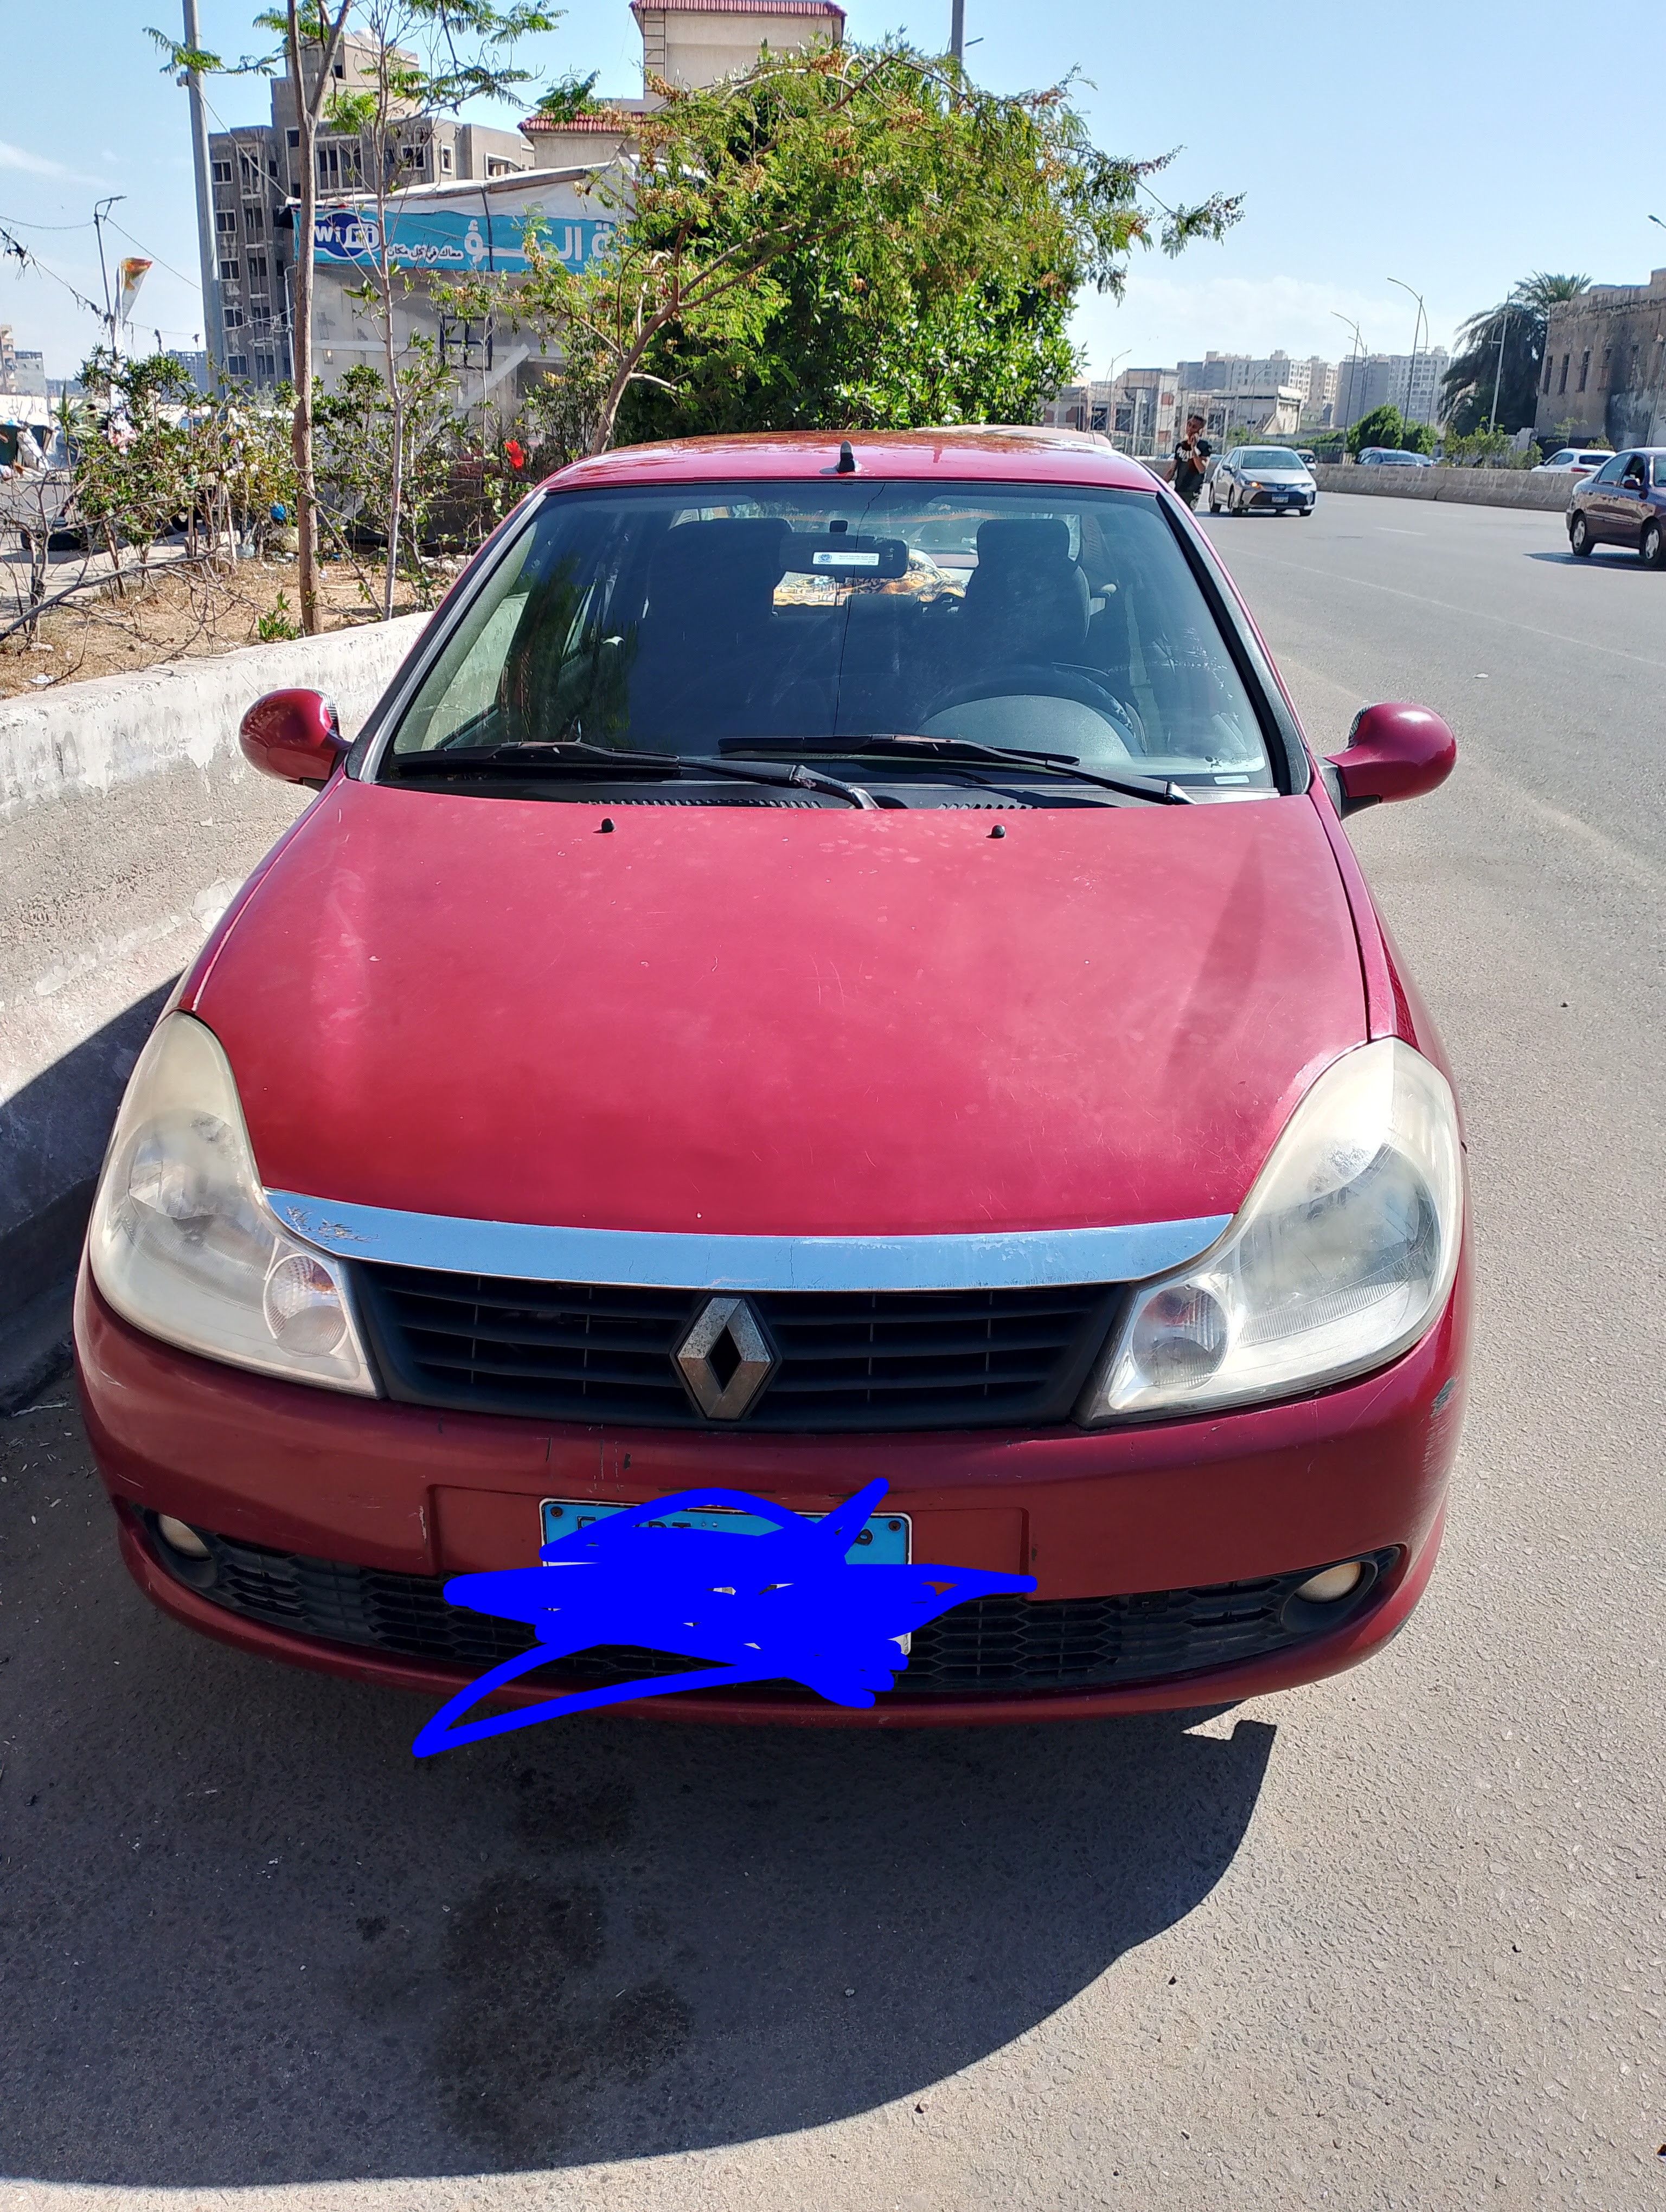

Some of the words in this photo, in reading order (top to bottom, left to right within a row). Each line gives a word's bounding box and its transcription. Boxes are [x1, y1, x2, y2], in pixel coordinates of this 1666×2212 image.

[387, 246, 408, 256] مكان
[411, 247, 425, 258] كل
[426, 248, 437, 260] في
[440, 247, 462, 256] معاك
